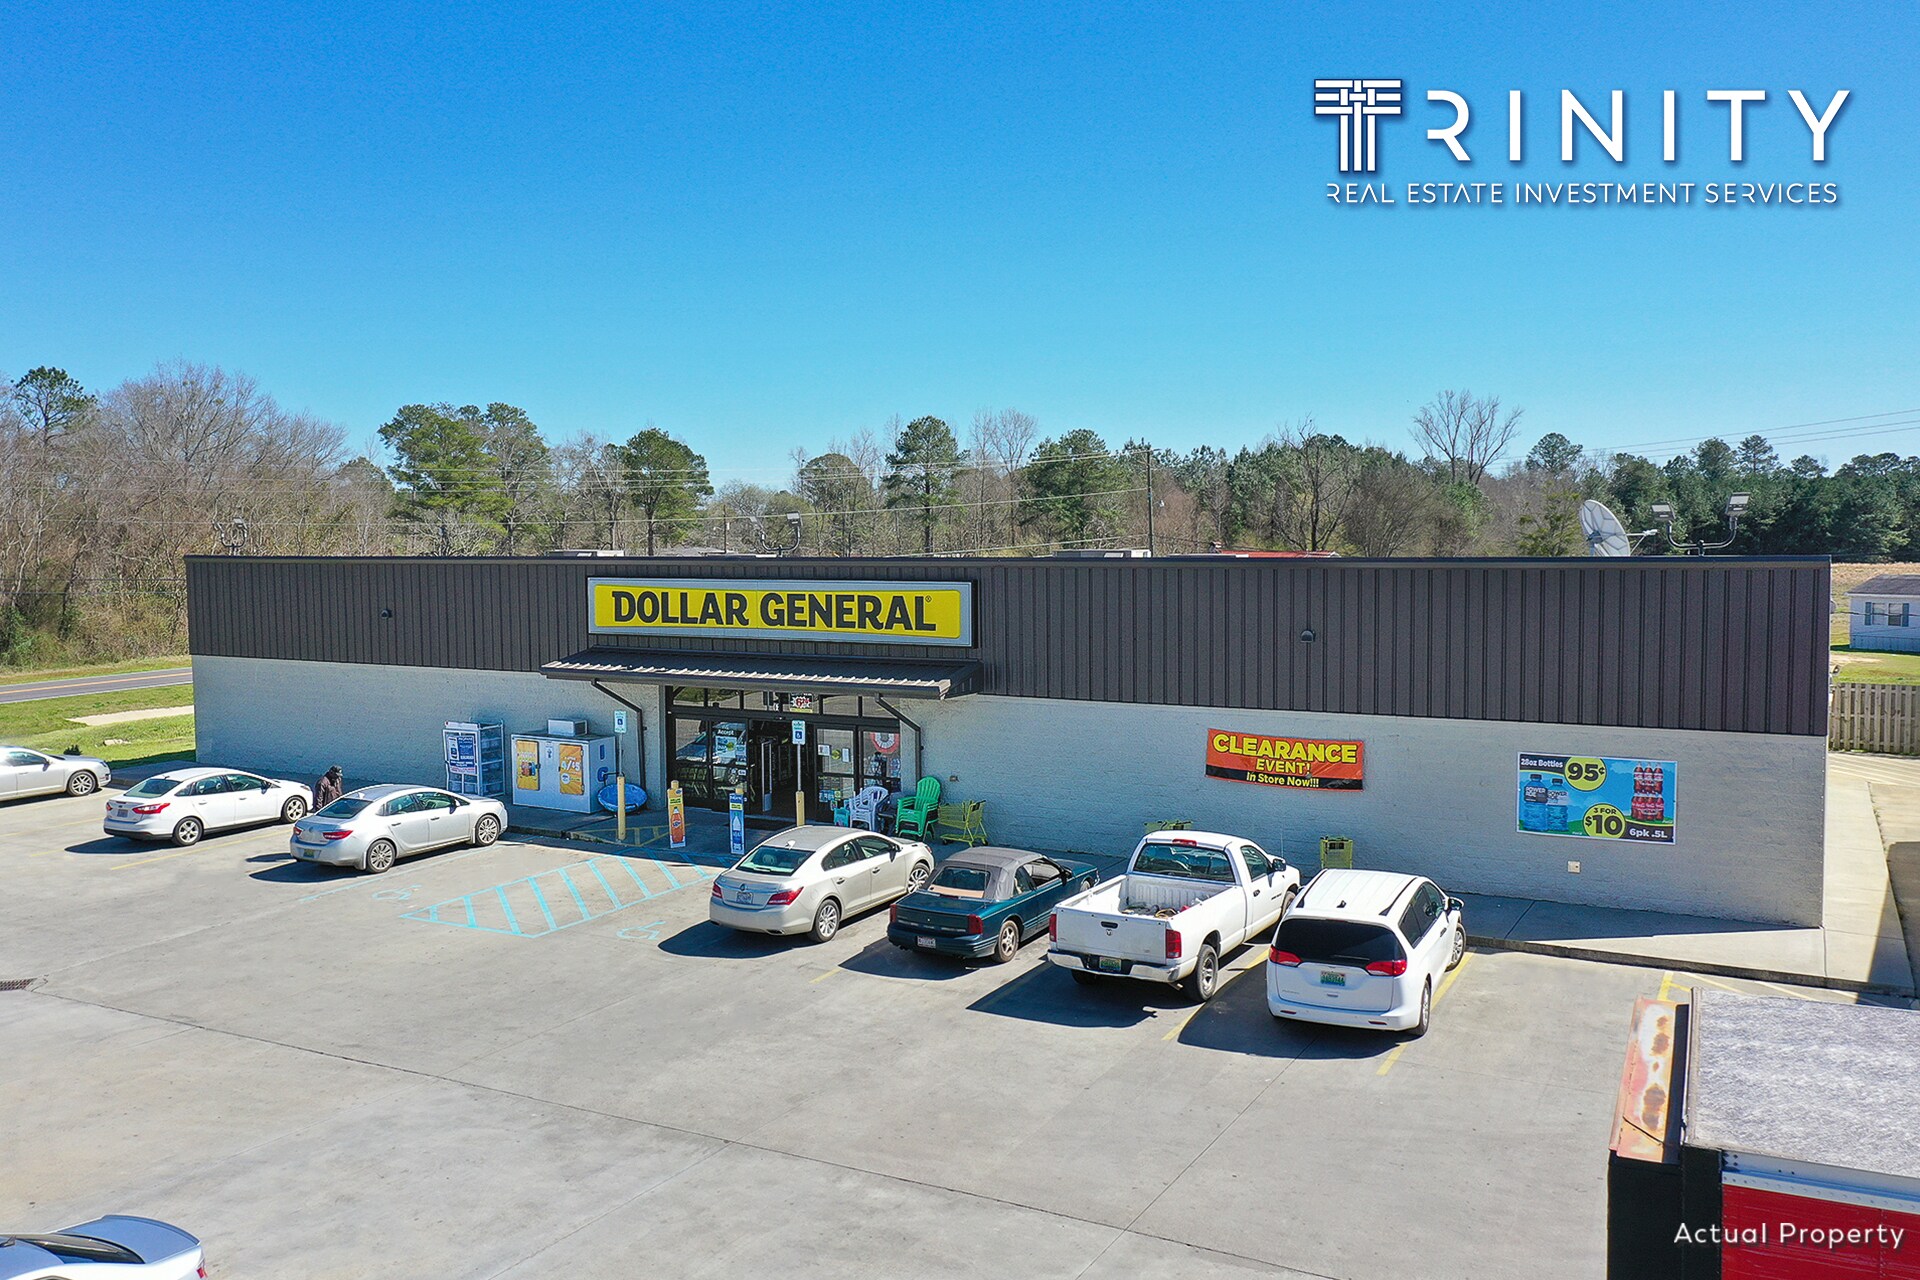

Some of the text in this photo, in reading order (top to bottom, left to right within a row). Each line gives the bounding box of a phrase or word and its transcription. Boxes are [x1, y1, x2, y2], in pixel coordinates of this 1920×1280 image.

[612, 590, 937, 631] DOLLAR GENERAL
[1213, 733, 1358, 763] CLEARANCE
[1255, 758, 1311, 774] EVENT!
[1538, 759, 1563, 769] Bottles
[1246, 772, 1320, 788] In Store Now!!!
[1584, 814, 1623, 836] $10
[1629, 828, 1668, 839] 6pk .5L
